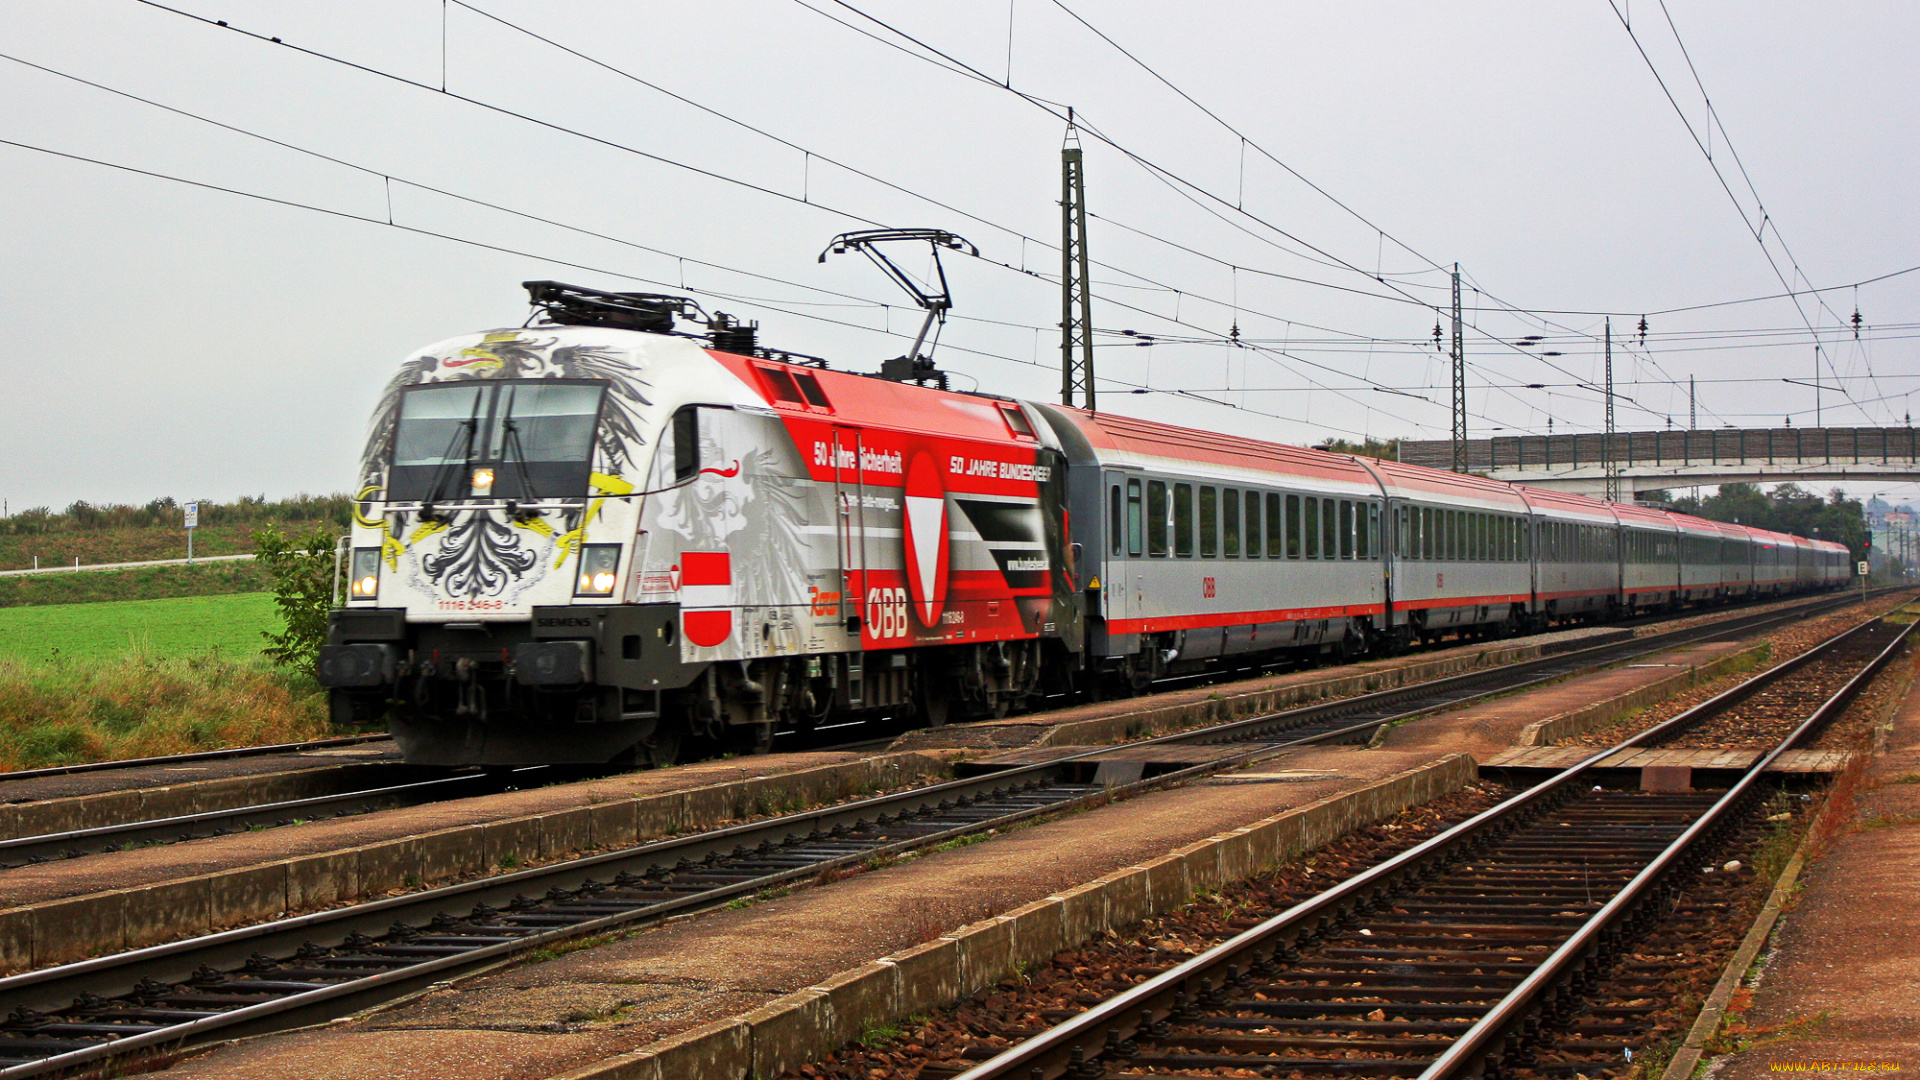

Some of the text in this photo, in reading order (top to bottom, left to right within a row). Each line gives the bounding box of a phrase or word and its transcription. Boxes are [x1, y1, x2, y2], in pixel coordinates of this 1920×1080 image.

[813, 441, 828, 466] 50
[949, 455, 964, 474] 50
[965, 458, 998, 478] JAHRE
[1167, 488, 1174, 527] 2
[438, 600, 465, 611] 1116
[868, 587, 908, 640] ÖBB
[536, 617, 593, 628] SIEMENS
